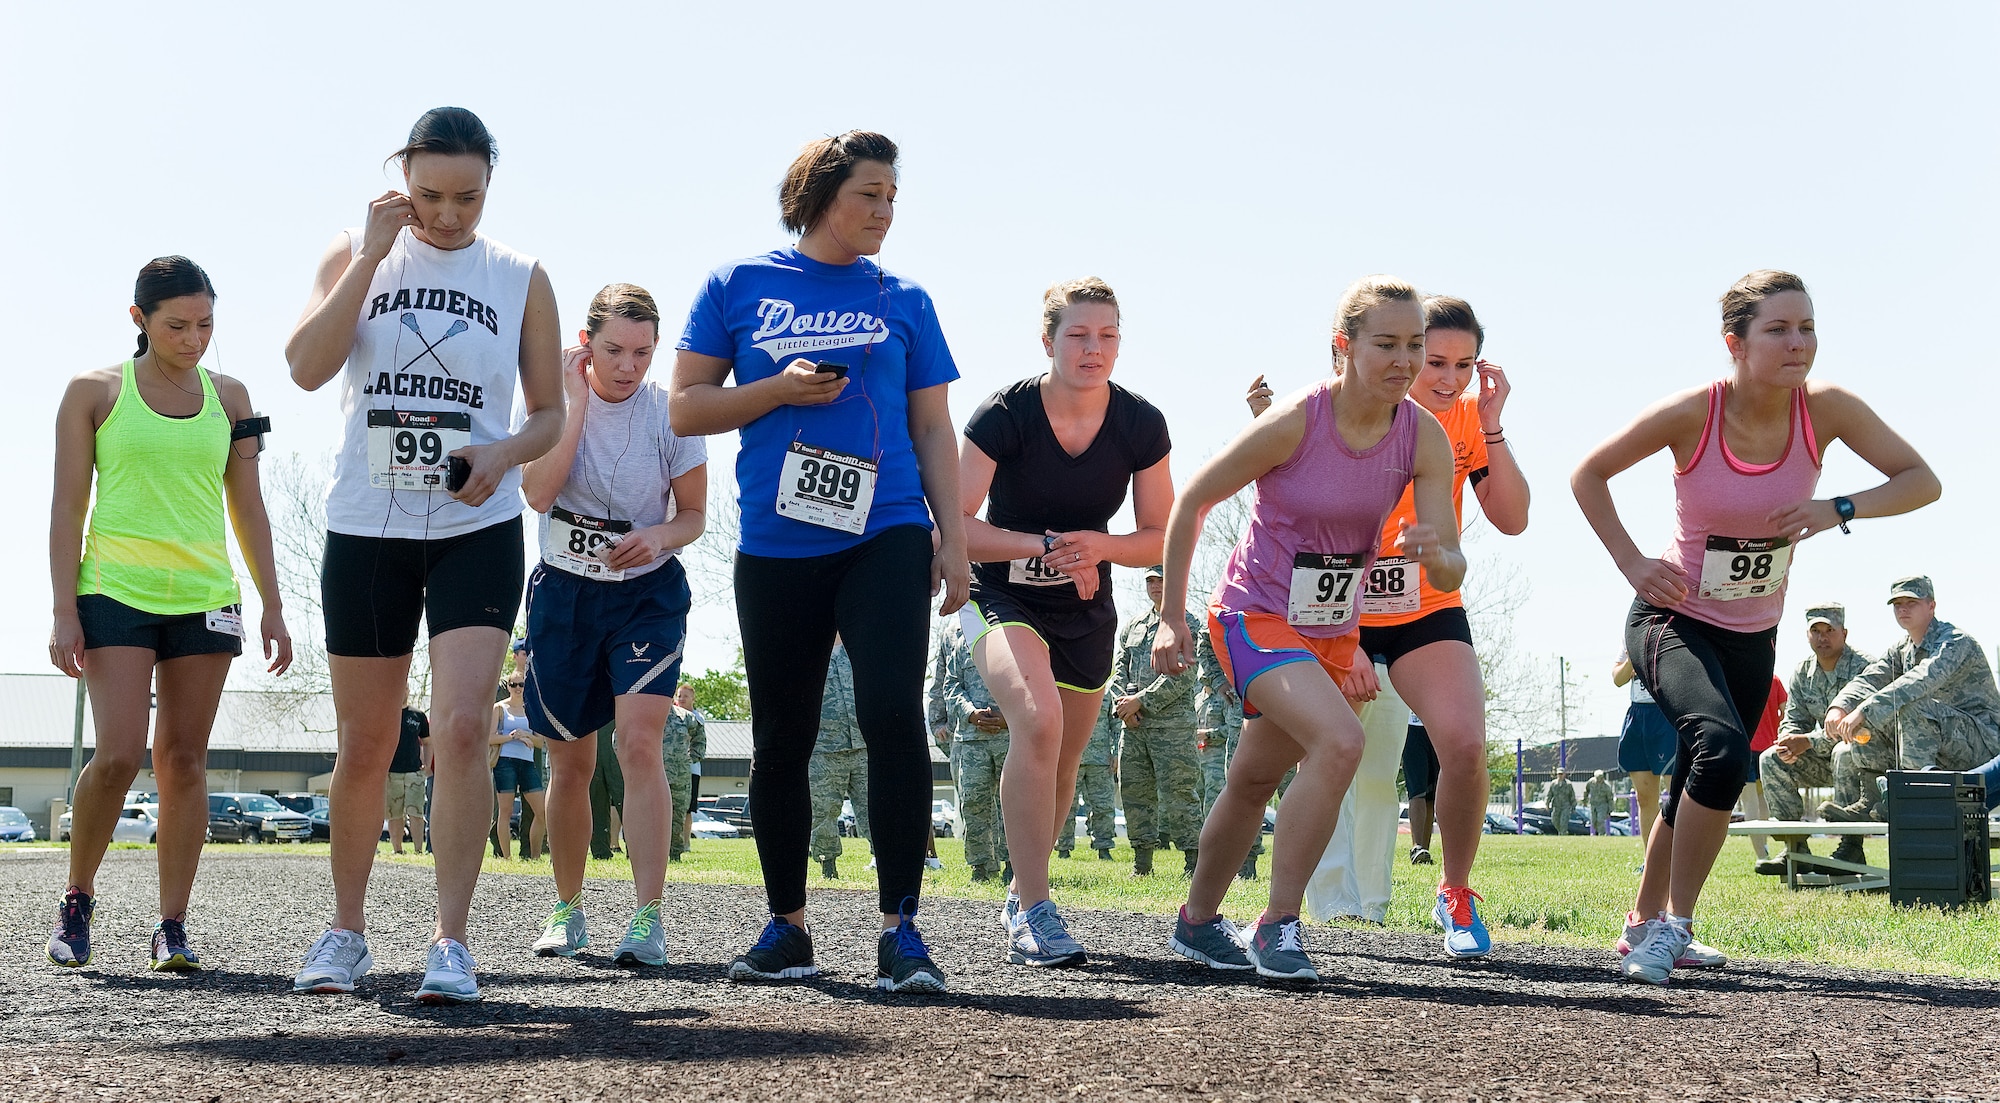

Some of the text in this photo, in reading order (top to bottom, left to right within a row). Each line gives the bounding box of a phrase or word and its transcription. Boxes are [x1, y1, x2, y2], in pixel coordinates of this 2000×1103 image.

[368, 288, 498, 336] RAIDERS
[752, 298, 883, 341] Dover
[777, 336, 855, 350] Little League
[363, 371, 484, 409] LACROSSE
[409, 415, 438, 423] RoadID
[395, 430, 443, 465] 99
[797, 458, 861, 503] 399
[1729, 553, 1773, 581] 98
[1316, 572, 1354, 602] 97
